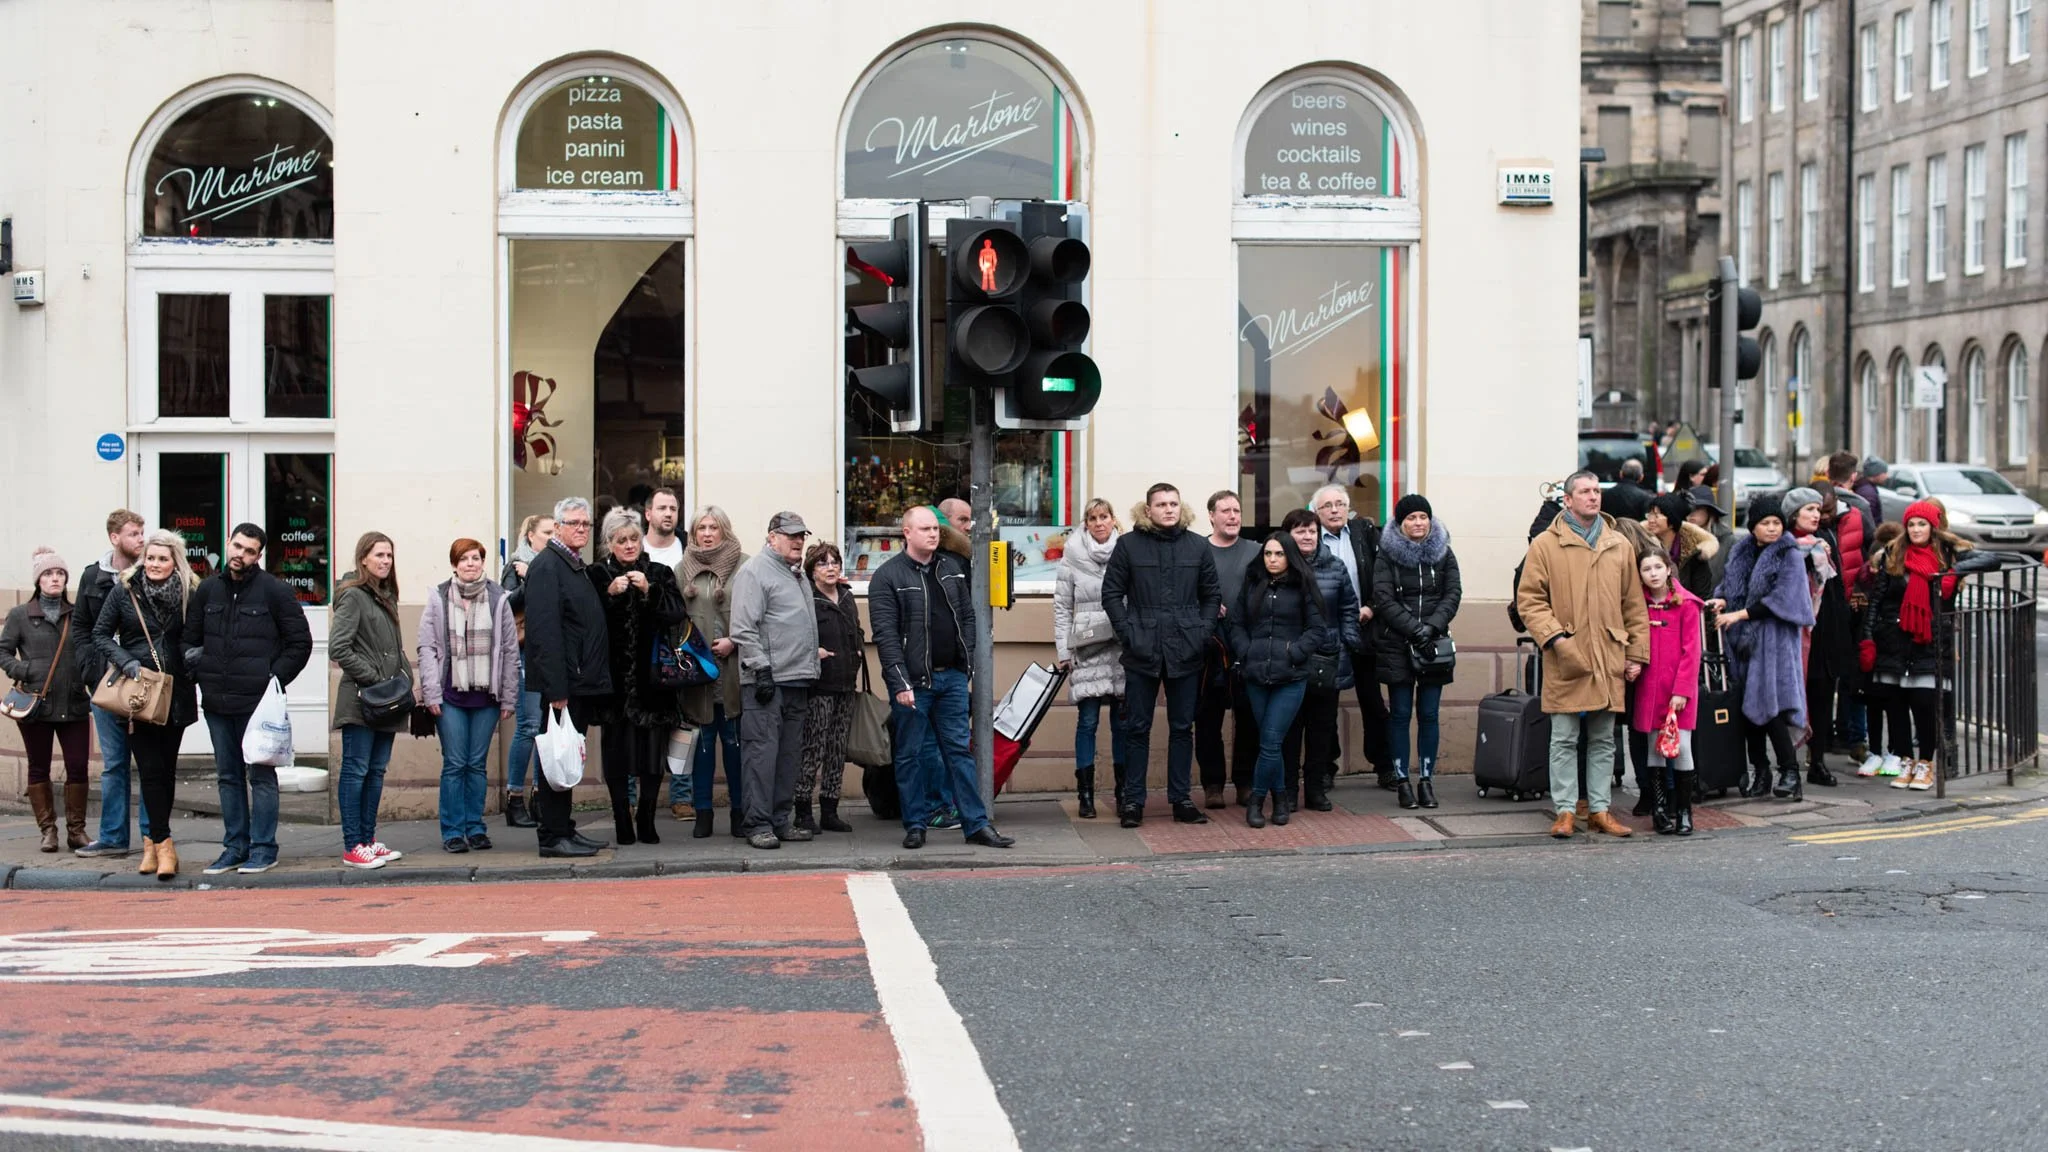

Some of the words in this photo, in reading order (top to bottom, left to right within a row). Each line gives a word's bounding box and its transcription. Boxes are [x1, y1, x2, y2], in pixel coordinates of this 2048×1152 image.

[569, 84, 622, 106] pizza
[1292, 91, 1346, 109] beers
[568, 113, 623, 133] pasta
[865, 90, 1042, 164] Martone
[1291, 118, 1347, 136] wines
[565, 139, 625, 161] panini
[1277, 145, 1361, 163] cocktails
[155, 143, 322, 210] Martone
[546, 166, 575, 184] ice
[581, 170, 644, 184] cream
[1261, 173, 1291, 190] tea
[1297, 172, 1312, 190] &
[1318, 172, 1377, 190] coffee
[1506, 174, 1551, 184] IMMS
[1239, 280, 1374, 350] Martone
[175, 516, 206, 527] pasta
[288, 517, 306, 527] tea
[281, 530, 315, 542] coffee
[184, 545, 208, 557] anini
